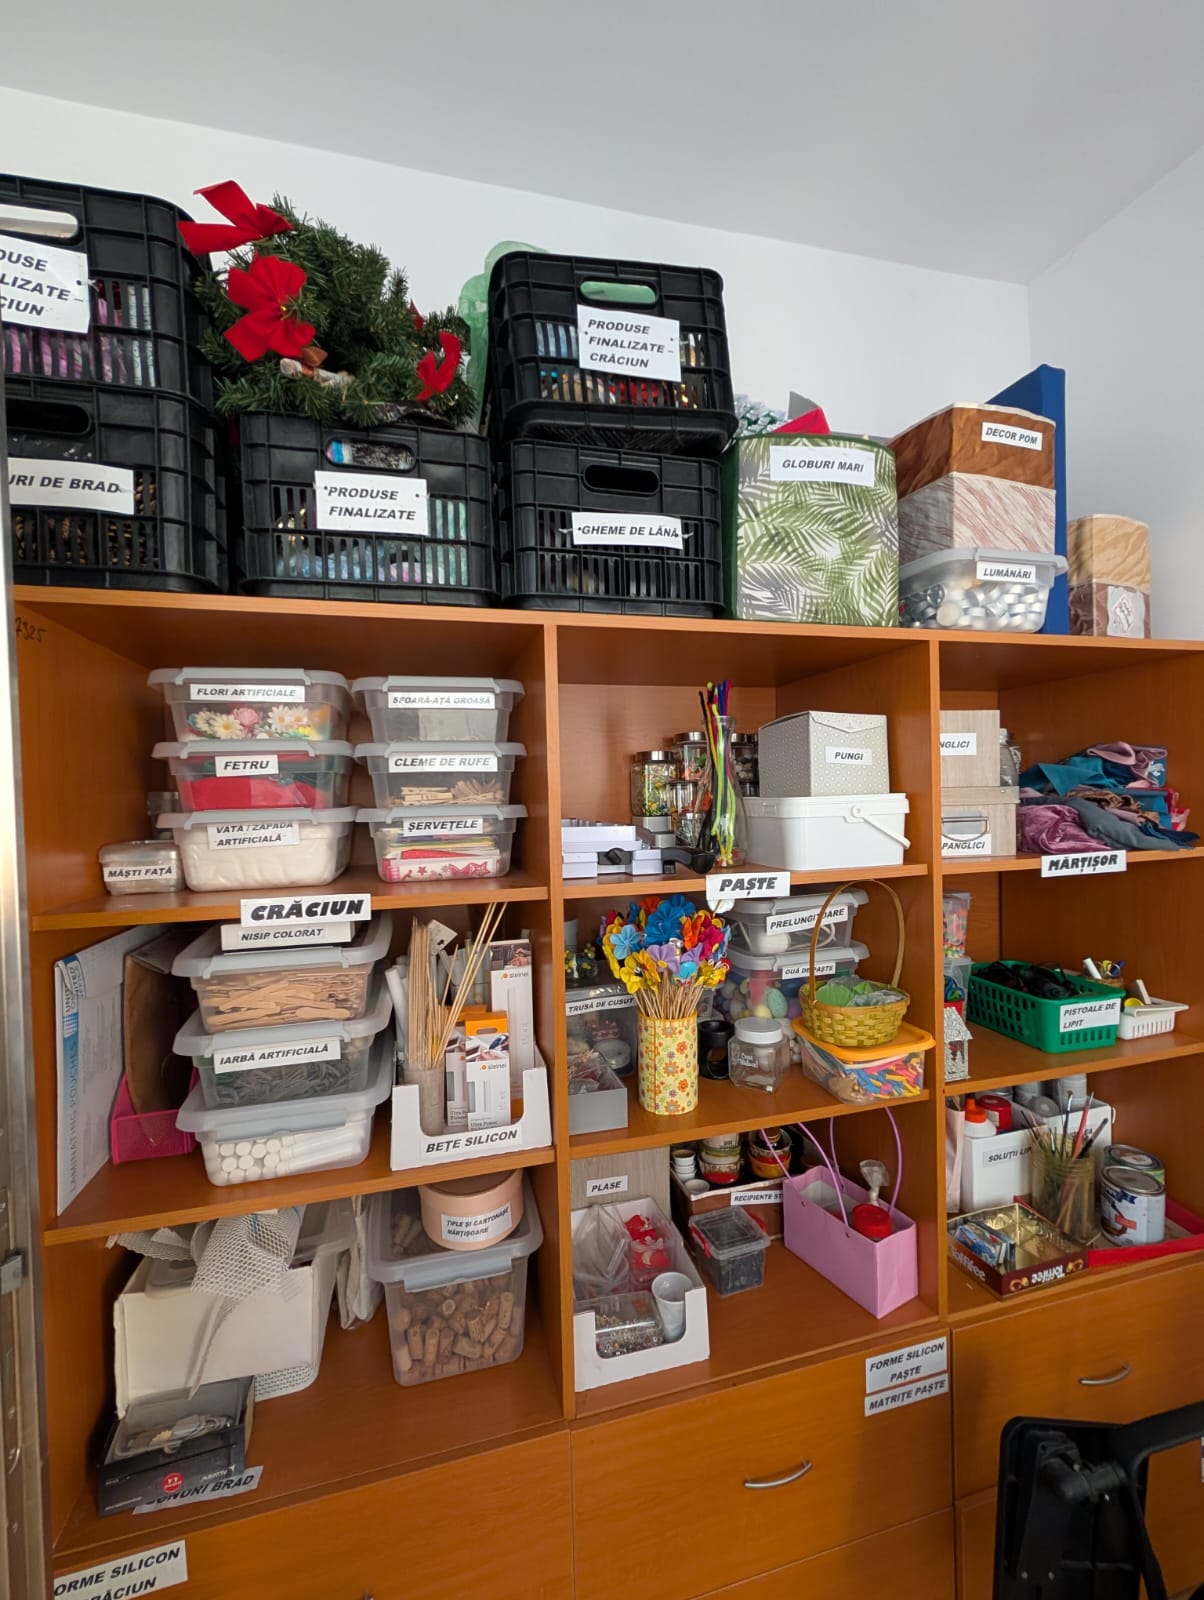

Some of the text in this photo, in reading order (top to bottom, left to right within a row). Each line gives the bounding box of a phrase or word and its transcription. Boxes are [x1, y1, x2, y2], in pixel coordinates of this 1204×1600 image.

[588, 318, 650, 335] PRODUSE
[588, 336, 664, 354] FINALIZATE
[589, 351, 650, 368] CRĂCIUN
[985, 427, 1038, 444] DECOR POM
[782, 458, 865, 473] GLOBURI MARI
[39, 476, 65, 488] DE
[69, 478, 120, 493] BRAD
[328, 485, 399, 501] PRODUSE
[328, 505, 417, 521] FINALIZATE
[581, 525, 626, 536] GHEME
[629, 526, 646, 536] DE
[196, 688, 297, 697] FLORI ARTIFICIALE
[394, 757, 491, 767] CLEME DE RUFE
[834, 751, 864, 761] PUNGI
[223, 760, 270, 771] FETRU
[217, 833, 282, 846] ARTIFICIALĂ
[942, 841, 985, 850] PANGLICI
[1048, 854, 1118, 872] MĂRȚIȘOR
[718, 876, 778, 895] PAȘTE
[250, 899, 365, 922] CRĂCIUN
[241, 928, 323, 942] NISIP COLORAT
[1063, 1002, 1116, 1017] PISTOALE DE
[1063, 1019, 1084, 1029] LIPIT
[219, 1043, 329, 1065] IARBĂ ARTIFICIALĂ
[464, 1129, 518, 1146] SILICON
[591, 1180, 622, 1192] PLASE
[869, 1342, 945, 1373] FORME SILICON
[889, 1365, 922, 1382] PAȘTE
[915, 1379, 947, 1398] PAȘTE
[211, 1474, 255, 1492] BRAD
[110, 1547, 180, 1579] SILICON
